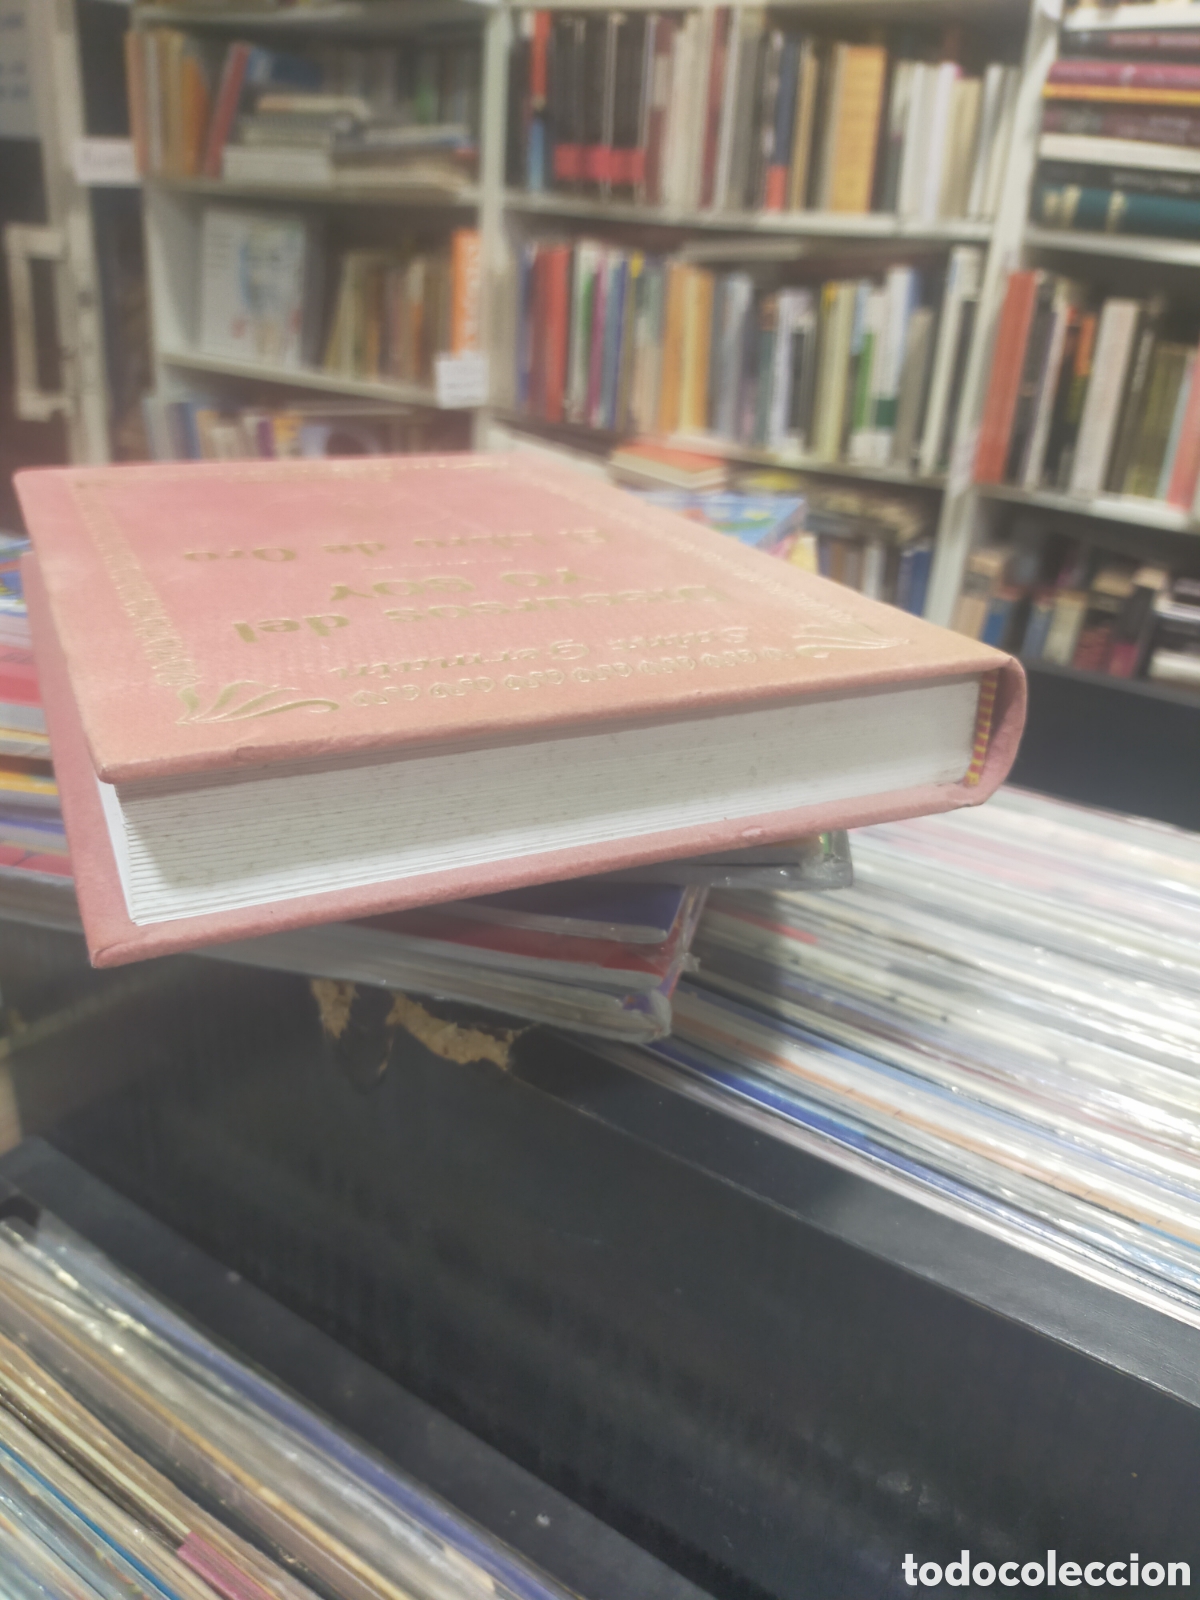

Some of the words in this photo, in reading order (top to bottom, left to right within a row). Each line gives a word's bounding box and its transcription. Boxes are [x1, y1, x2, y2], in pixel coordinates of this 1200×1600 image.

[321, 541, 387, 557] de
[329, 575, 476, 601] SOY
[500, 568, 603, 589] YO
[383, 585, 728, 623] Discursos
[232, 613, 350, 643] del
[607, 626, 749, 651] Saint
[328, 638, 591, 680] Germain
